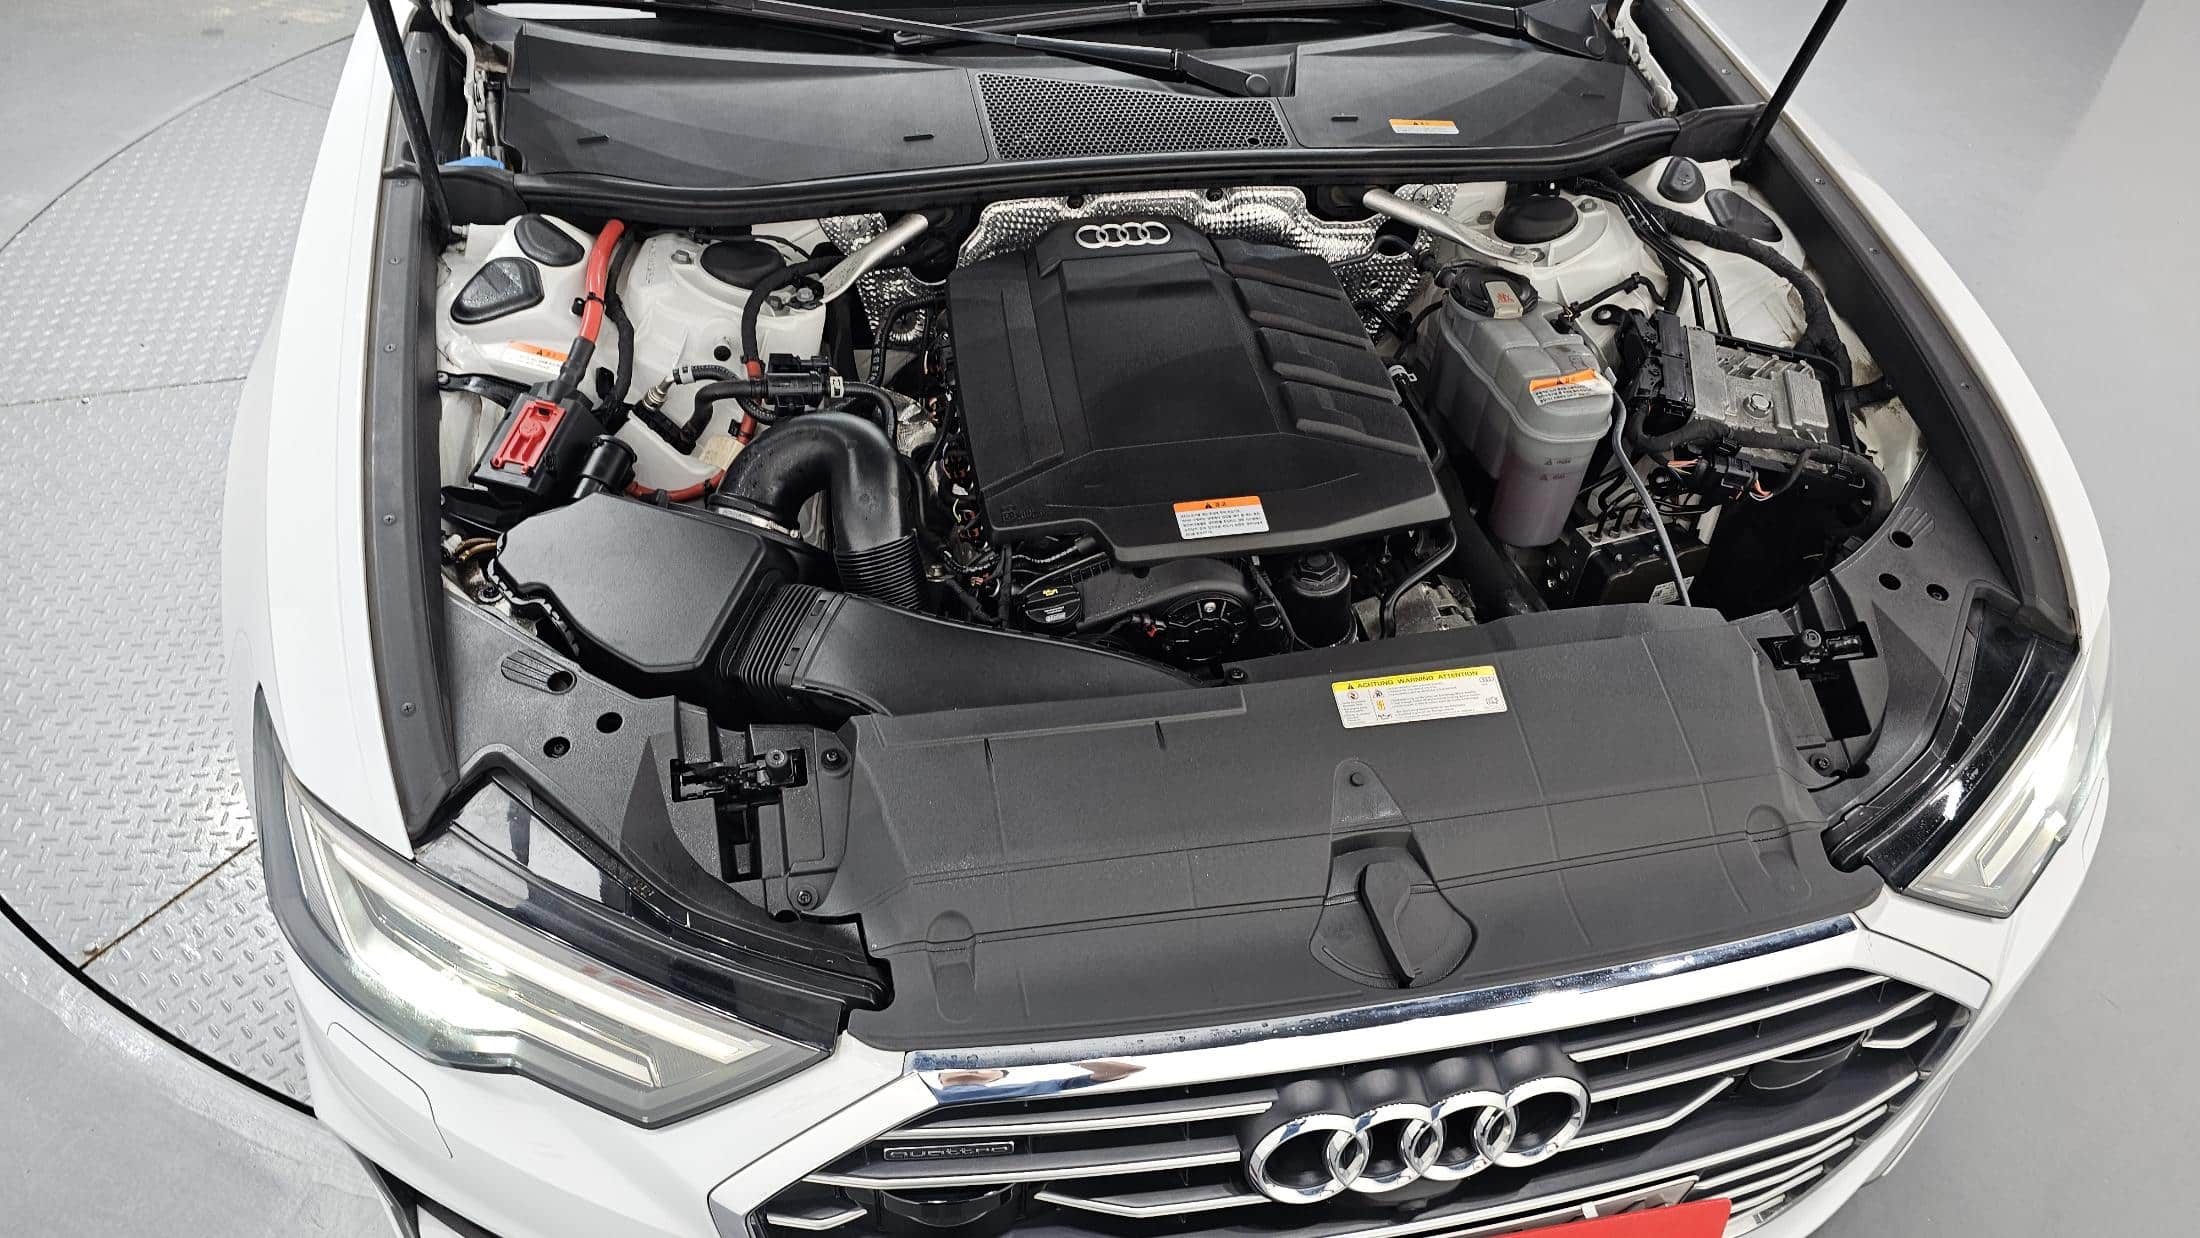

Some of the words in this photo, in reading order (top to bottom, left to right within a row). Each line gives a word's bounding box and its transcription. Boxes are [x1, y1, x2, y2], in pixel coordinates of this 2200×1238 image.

[1357, 680, 1394, 689] ACHTUNG
[1397, 675, 1434, 685] WARNING
[1438, 671, 1479, 680] ATTENTION
[890, 1146, 1008, 1160] quattro
